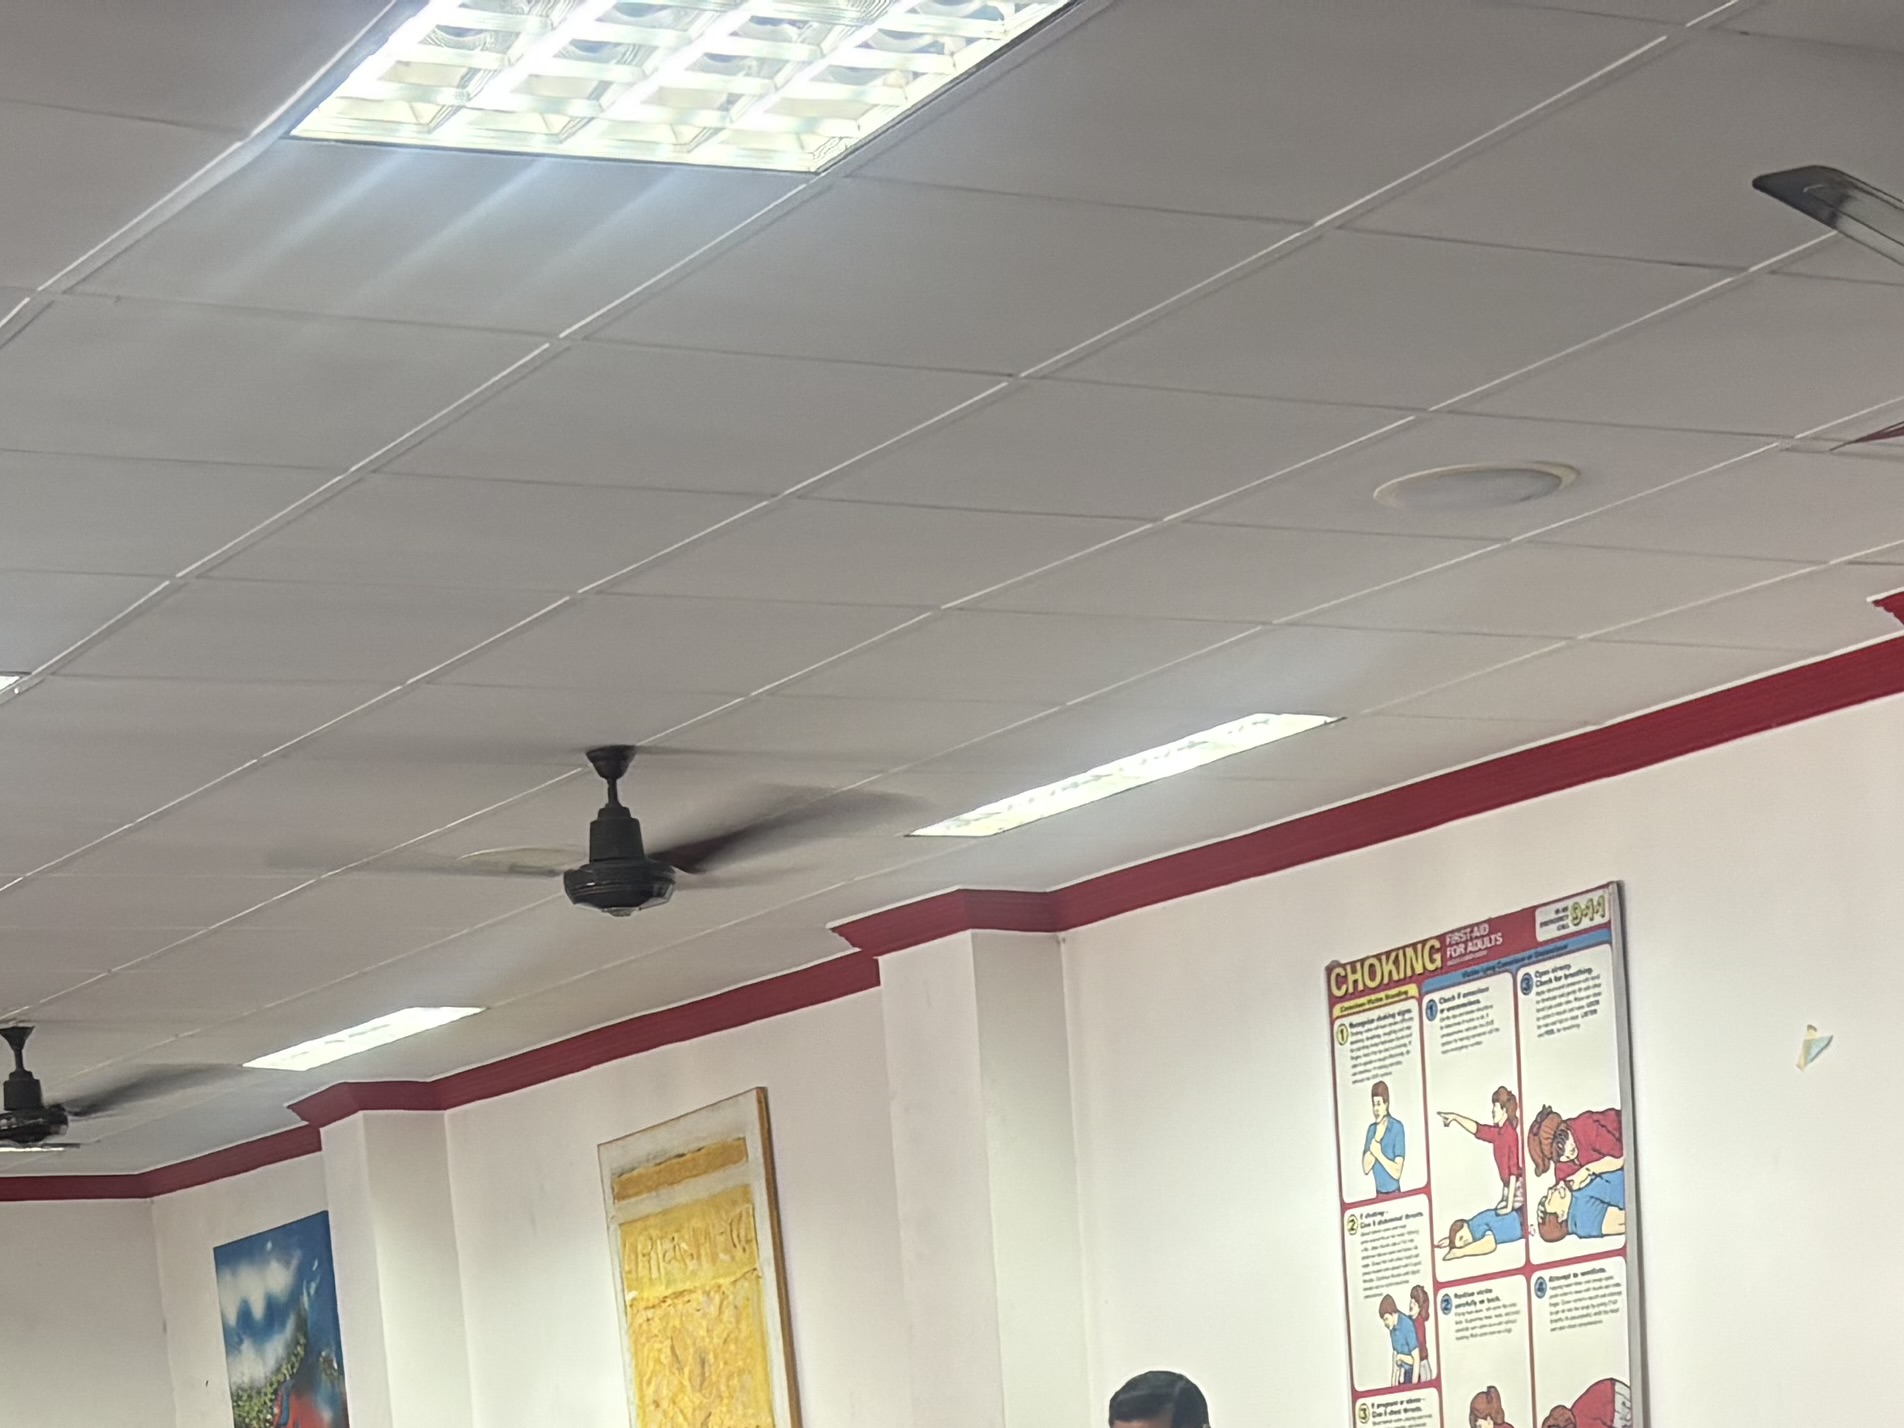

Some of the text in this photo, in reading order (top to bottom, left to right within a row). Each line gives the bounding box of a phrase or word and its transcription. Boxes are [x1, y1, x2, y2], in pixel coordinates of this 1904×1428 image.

[1329, 937, 1442, 997] CHOKING
[1447, 942, 1465, 959] FOR
[1466, 932, 1504, 955] ADULTS
